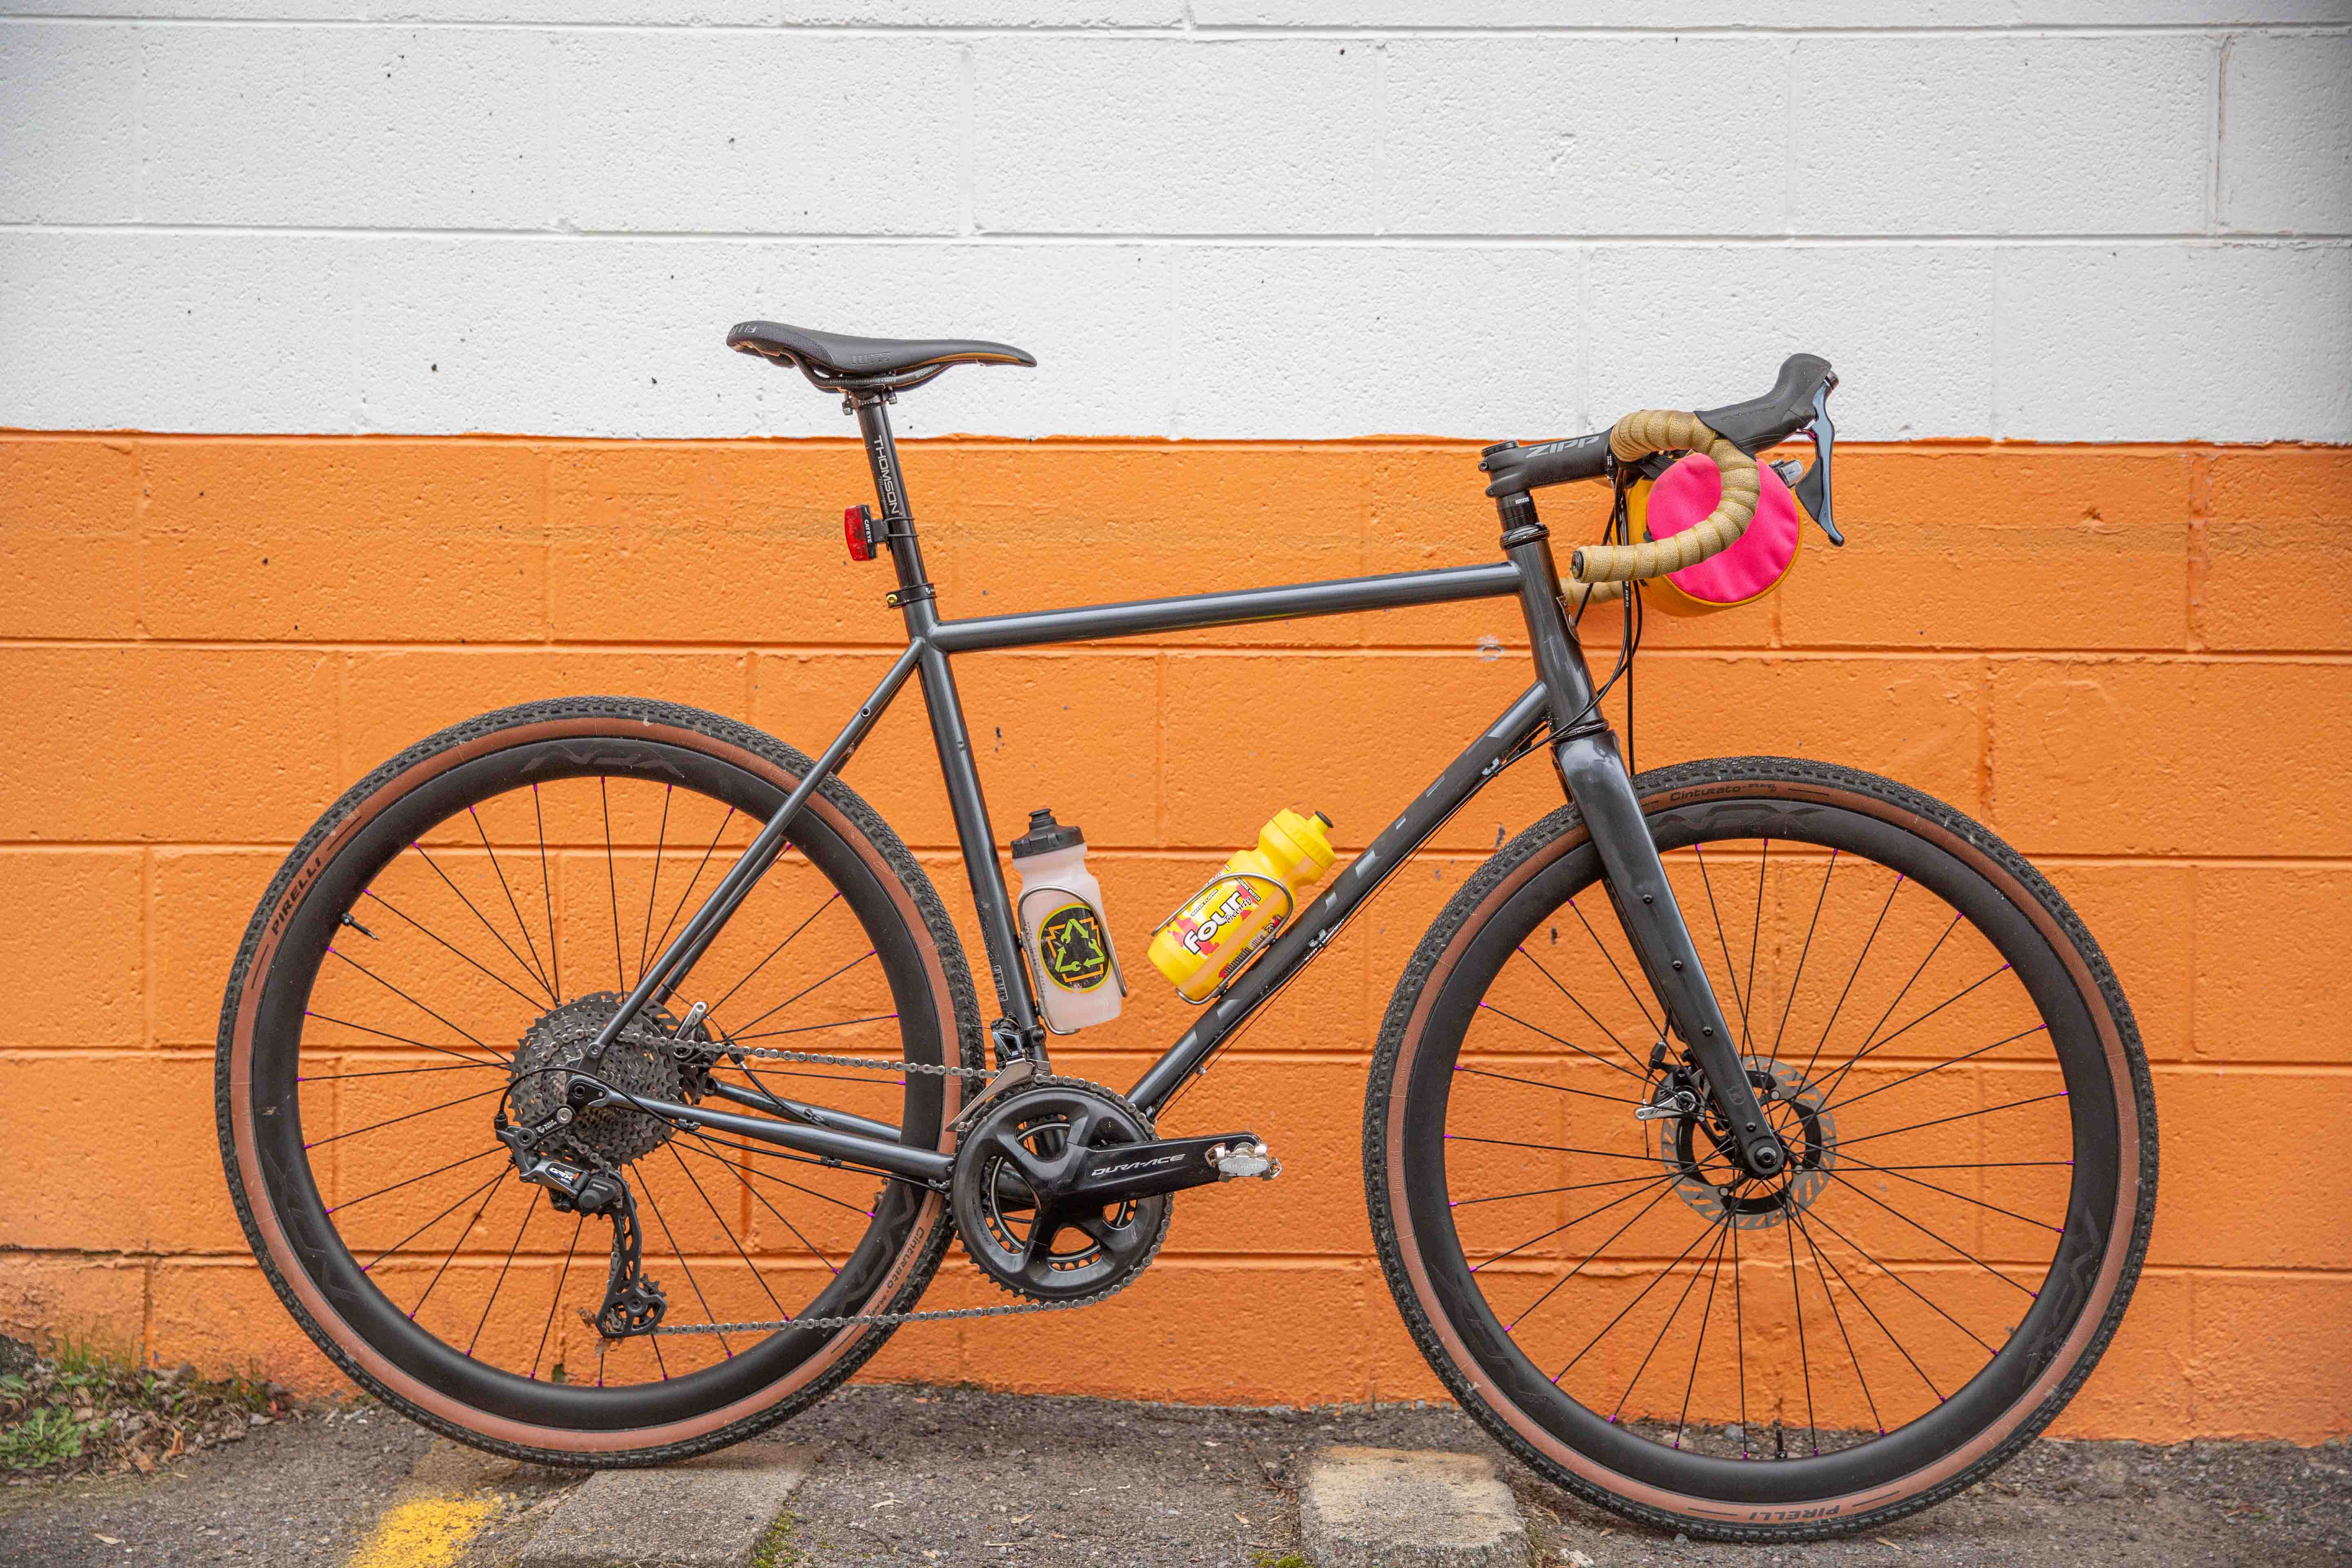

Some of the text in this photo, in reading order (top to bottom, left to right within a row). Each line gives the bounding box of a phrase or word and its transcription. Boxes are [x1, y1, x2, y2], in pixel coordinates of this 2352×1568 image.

[1526, 435, 1600, 458] ZIPP
[874, 435, 900, 514] THOMSON
[1670, 786, 1741, 802] Cinturato
[272, 857, 321, 935] PIRELLI
[1184, 891, 1242, 955] four
[549, 1167, 574, 1181] GRX
[1091, 1154, 1185, 1176] DURA-ACE
[1749, 1505, 1841, 1521] PIRELLI
